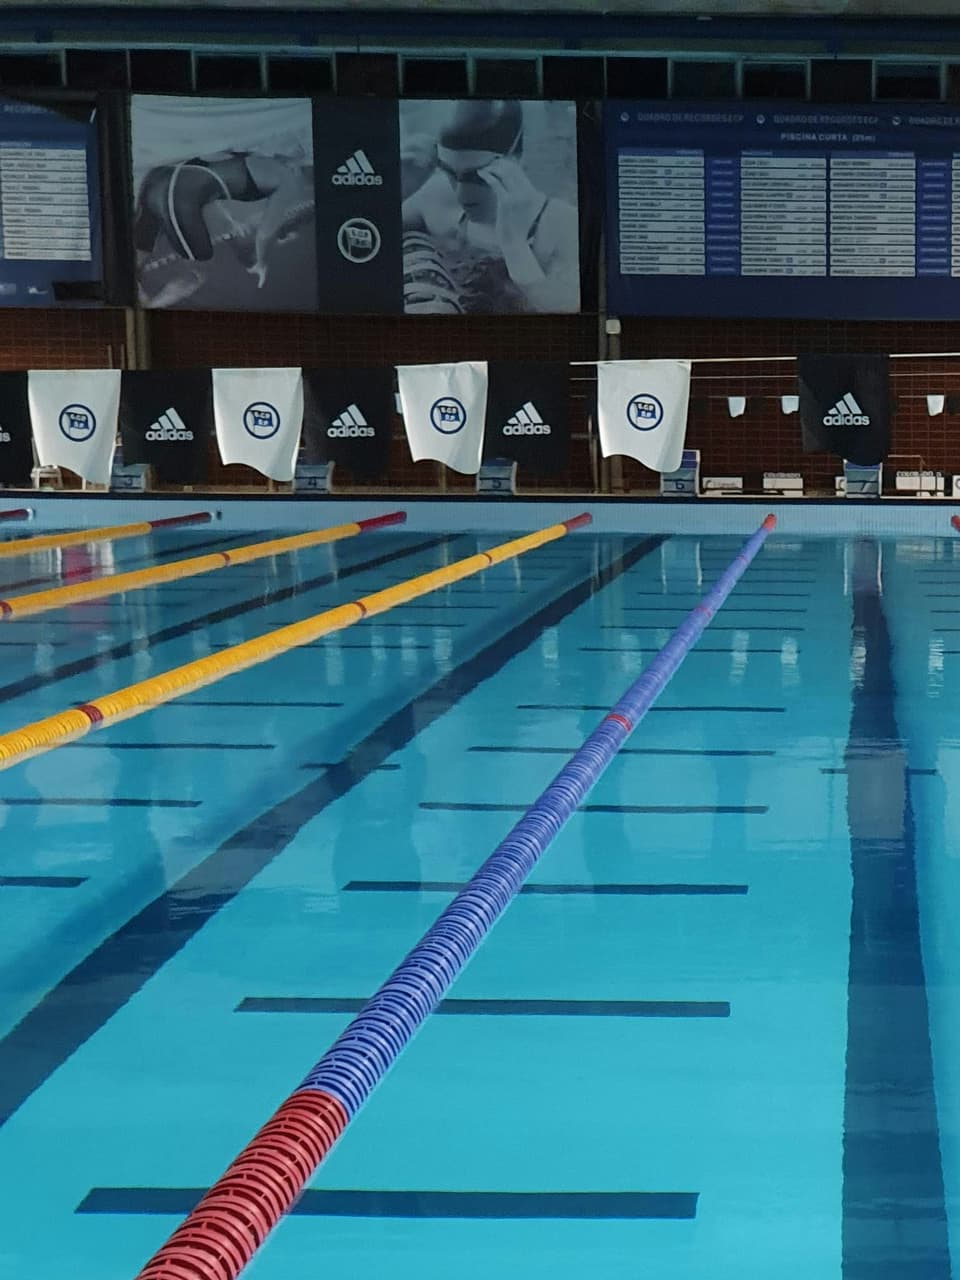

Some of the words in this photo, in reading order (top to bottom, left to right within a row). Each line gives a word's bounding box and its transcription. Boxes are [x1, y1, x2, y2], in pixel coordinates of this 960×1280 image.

[780, 133, 817, 142] PISCINA
[331, 172, 383, 186] adidas
[823, 413, 870, 426] adidas
[145, 428, 194, 441] adidas
[327, 424, 375, 437] adidas
[503, 422, 551, 436] adidas
[307, 477, 317, 487] 4
[492, 477, 502, 488] 5
